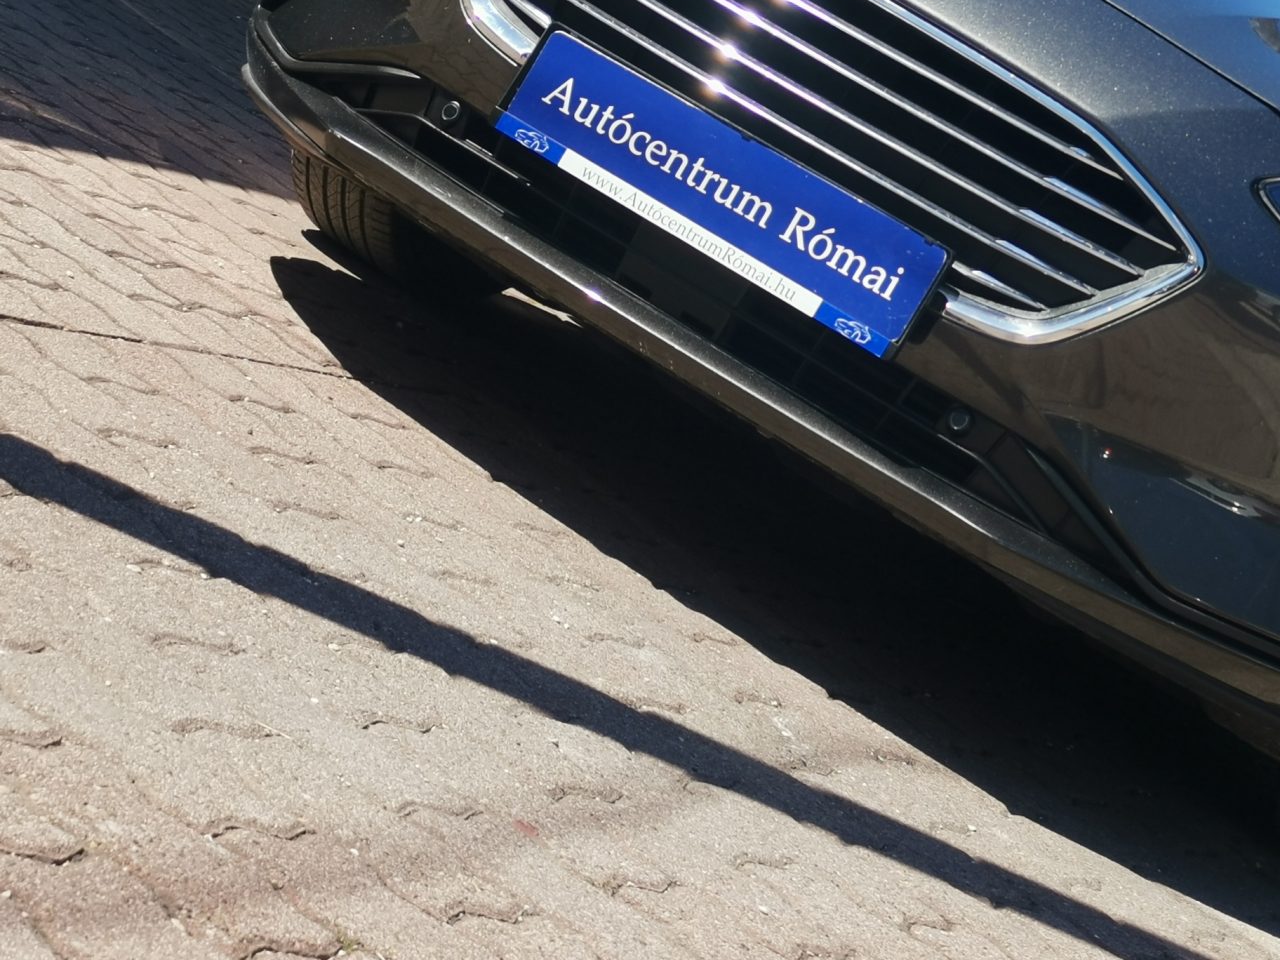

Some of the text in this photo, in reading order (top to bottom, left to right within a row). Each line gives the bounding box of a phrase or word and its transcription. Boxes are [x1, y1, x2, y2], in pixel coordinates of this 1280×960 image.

[541, 76, 906, 302] Autócentrum Római
[581, 164, 797, 302] www.AutócentrumRómai.hu
